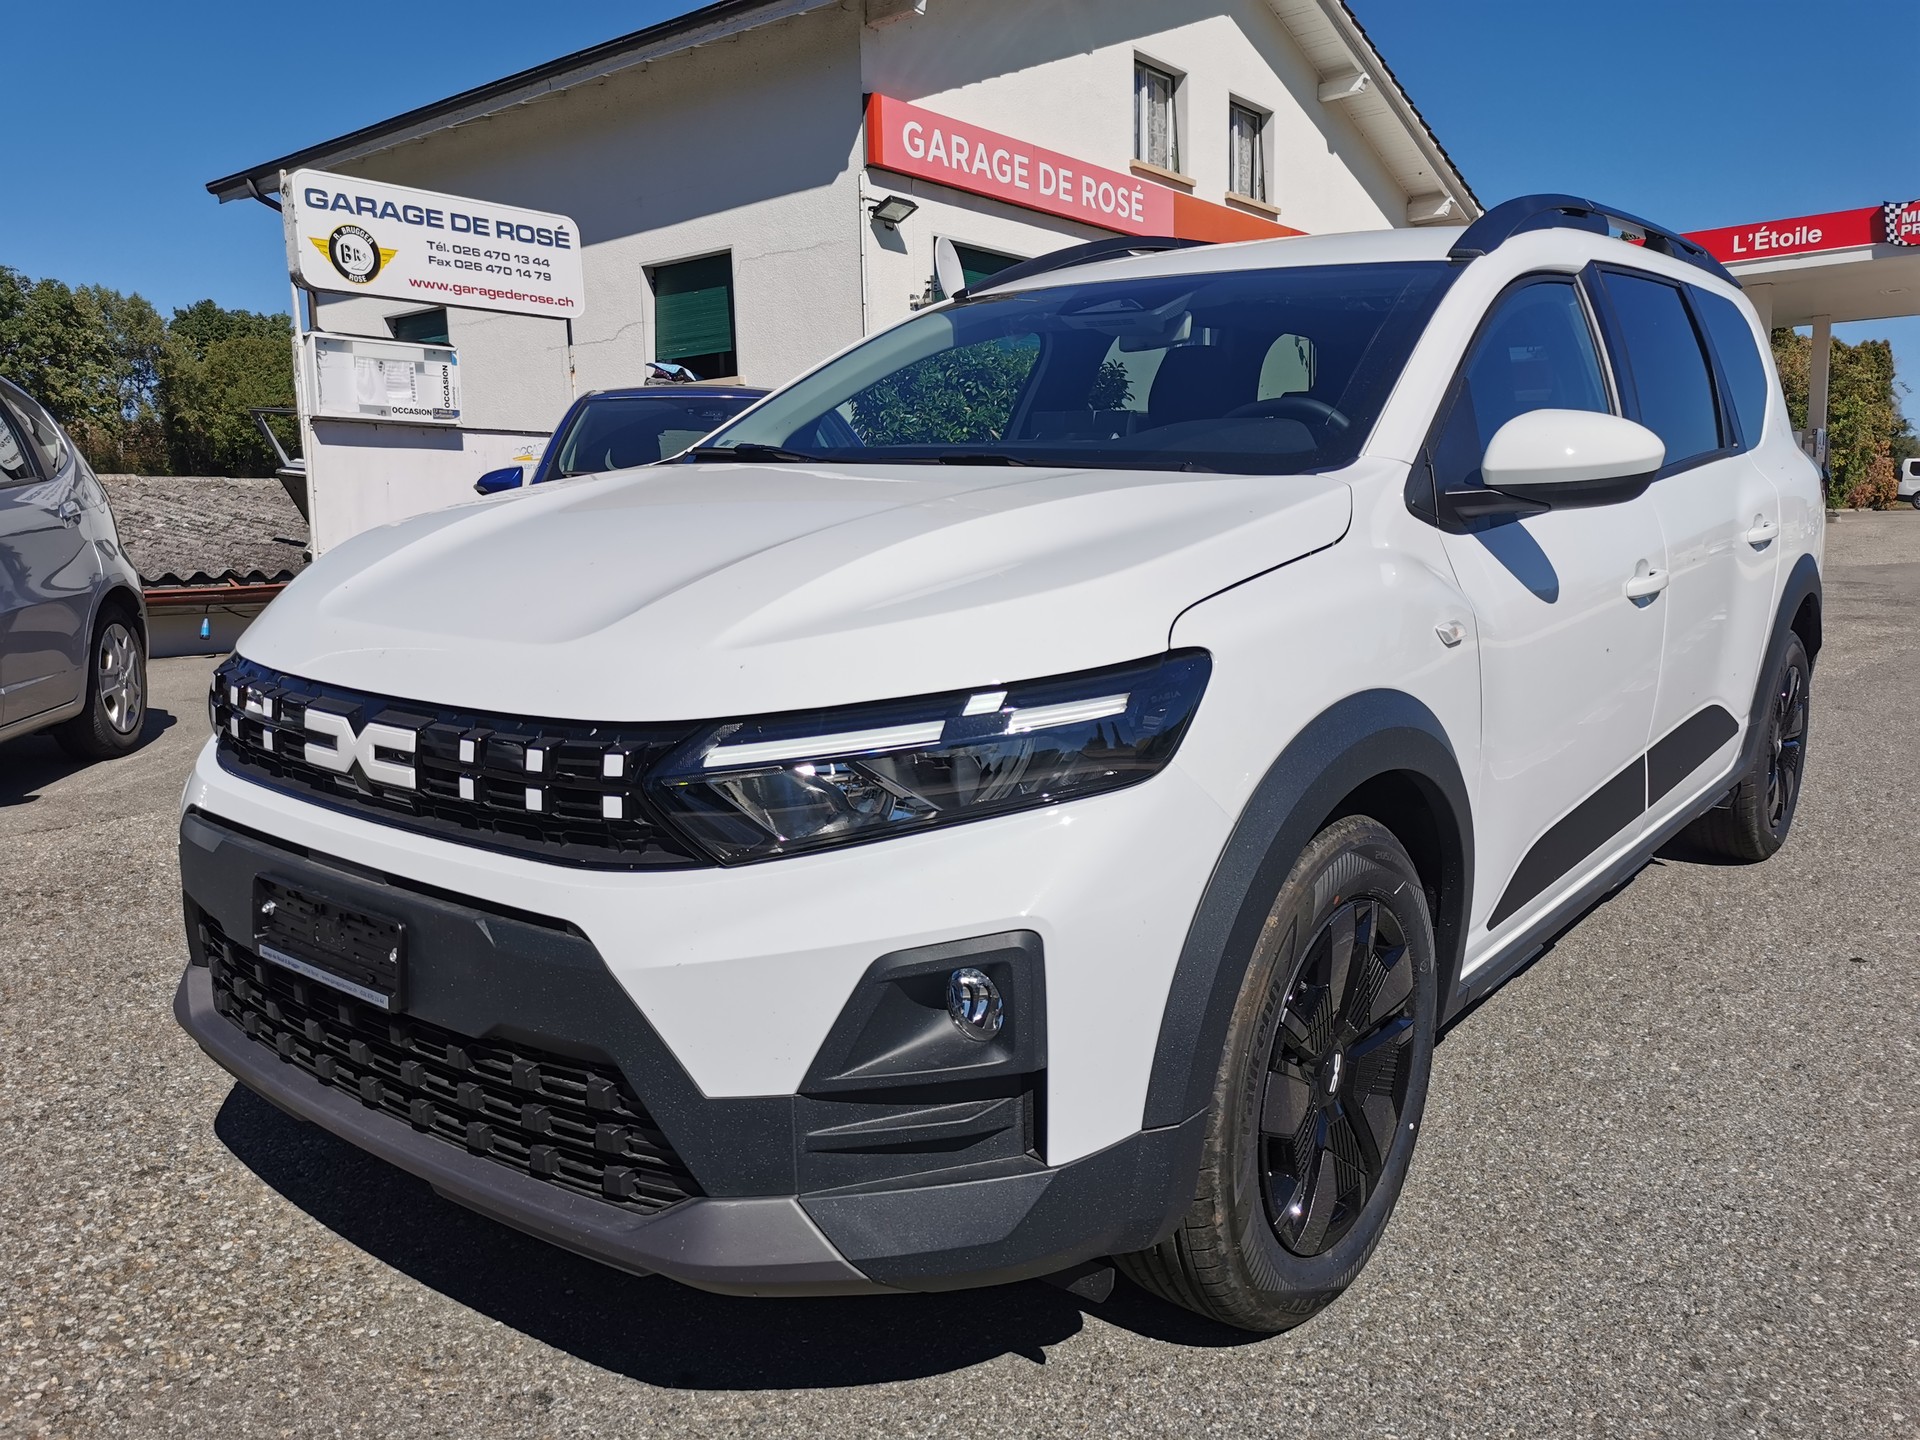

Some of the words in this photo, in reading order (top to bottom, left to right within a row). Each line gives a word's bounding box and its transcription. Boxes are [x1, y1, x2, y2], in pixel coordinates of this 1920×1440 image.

[902, 120, 1030, 191] GARAGE
[1039, 162, 1073, 202] DE
[1082, 175, 1144, 223] ROSÉ
[304, 187, 445, 230] GARAGE
[450, 212, 490, 237] DE
[496, 220, 571, 250] ROSÉ
[341, 226, 374, 245] BRUGGER
[1733, 226, 1823, 254] L'Étoile
[427, 240, 450, 254] Tél.
[452, 245, 481, 258] 026
[484, 249, 510, 262] 470
[514, 253, 530, 265] 13
[532, 256, 551, 268] 44
[428, 255, 452, 269] Fax
[454, 259, 483, 272] 026
[485, 264, 513, 277] 470
[409, 277, 575, 308] www.garagederose.ch
[442, 365, 450, 408] OCCASION
[392, 406, 432, 416] OCCASION
